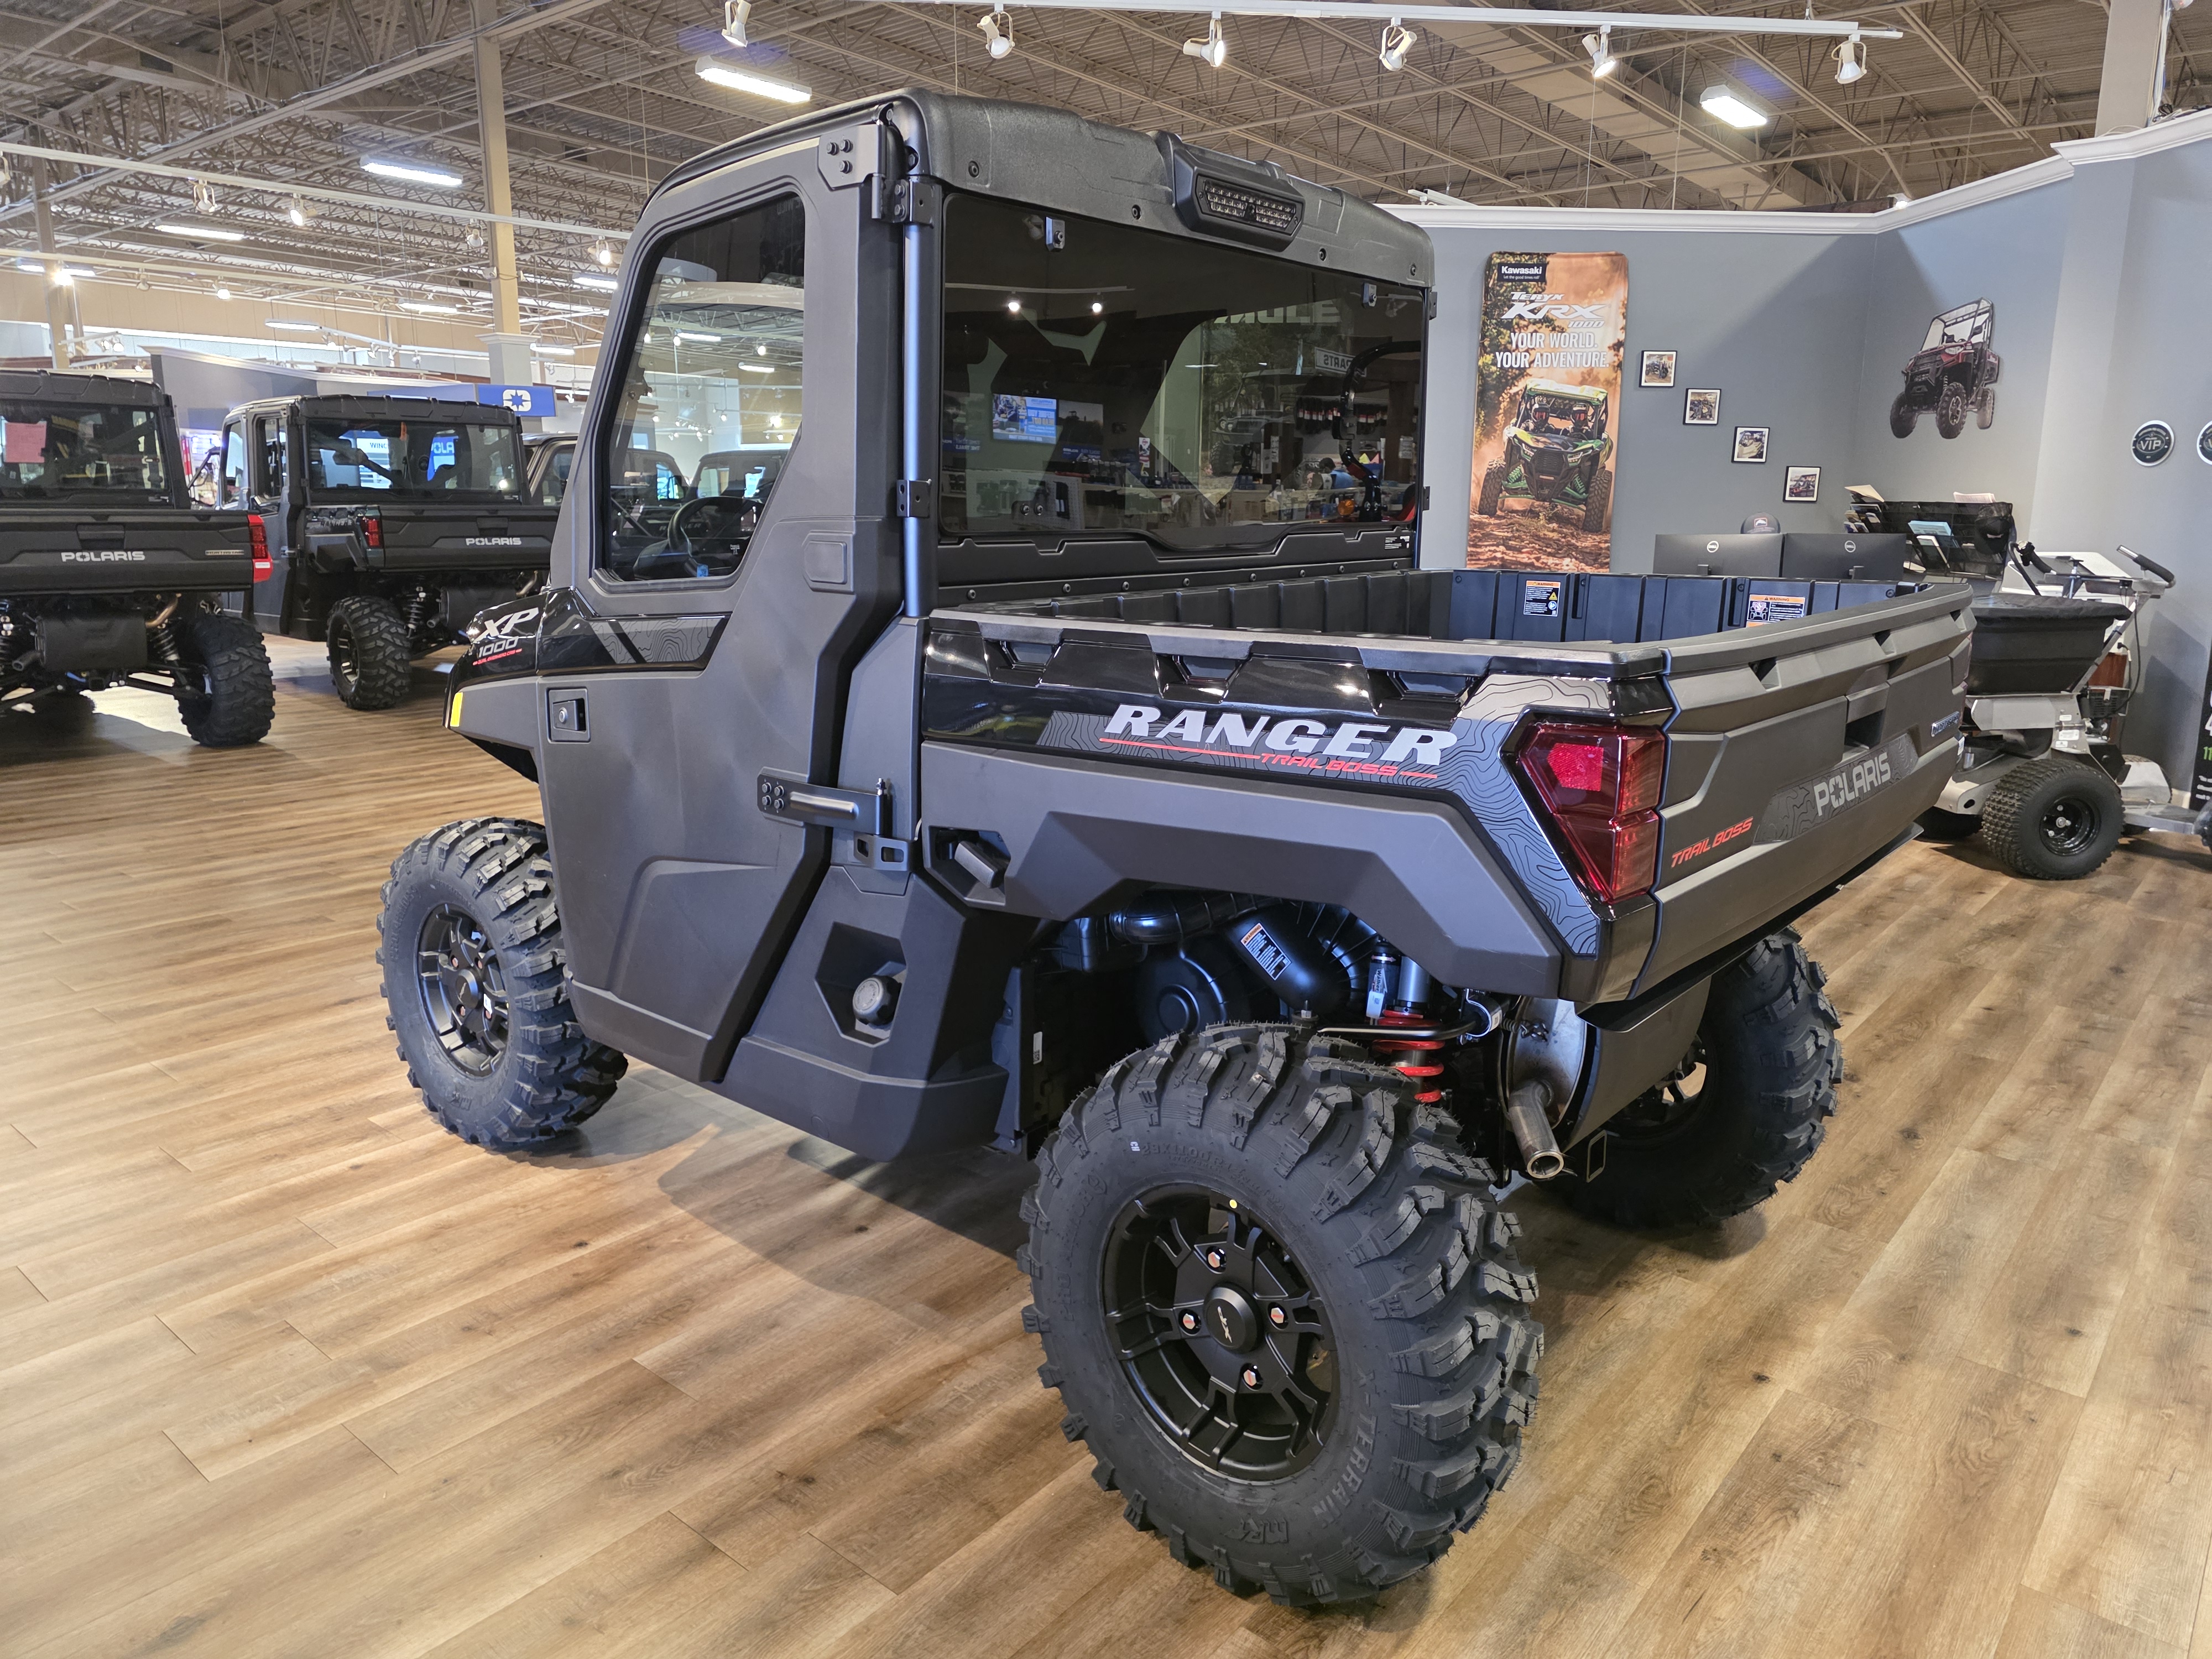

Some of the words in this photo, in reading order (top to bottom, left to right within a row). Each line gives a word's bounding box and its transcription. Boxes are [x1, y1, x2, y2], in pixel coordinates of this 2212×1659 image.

[1501, 266, 1542, 274] Kawasaki
[1510, 291, 1565, 302] TERYX
[1500, 301, 1607, 319] KRX
[1511, 332, 1545, 348] YOUR
[1550, 332, 1597, 348] WORLD.
[1496, 352, 1530, 367] YOUR
[1533, 352, 1609, 368] ADVENTURE.
[2140, 440, 2162, 450] VIP
[465, 537, 522, 546] POLARIS
[61, 551, 145, 562] POLARIS
[473, 607, 539, 644] XP
[479, 637, 519, 658] 1000
[1104, 704, 1458, 765] RANGER
[1261, 753, 1323, 769] TRAIL
[1325, 759, 1400, 776] BOSS
[1813, 752, 1891, 817] POLARIS
[1671, 837, 1711, 868] TRAIL
[1712, 816, 1754, 848] BOSS
